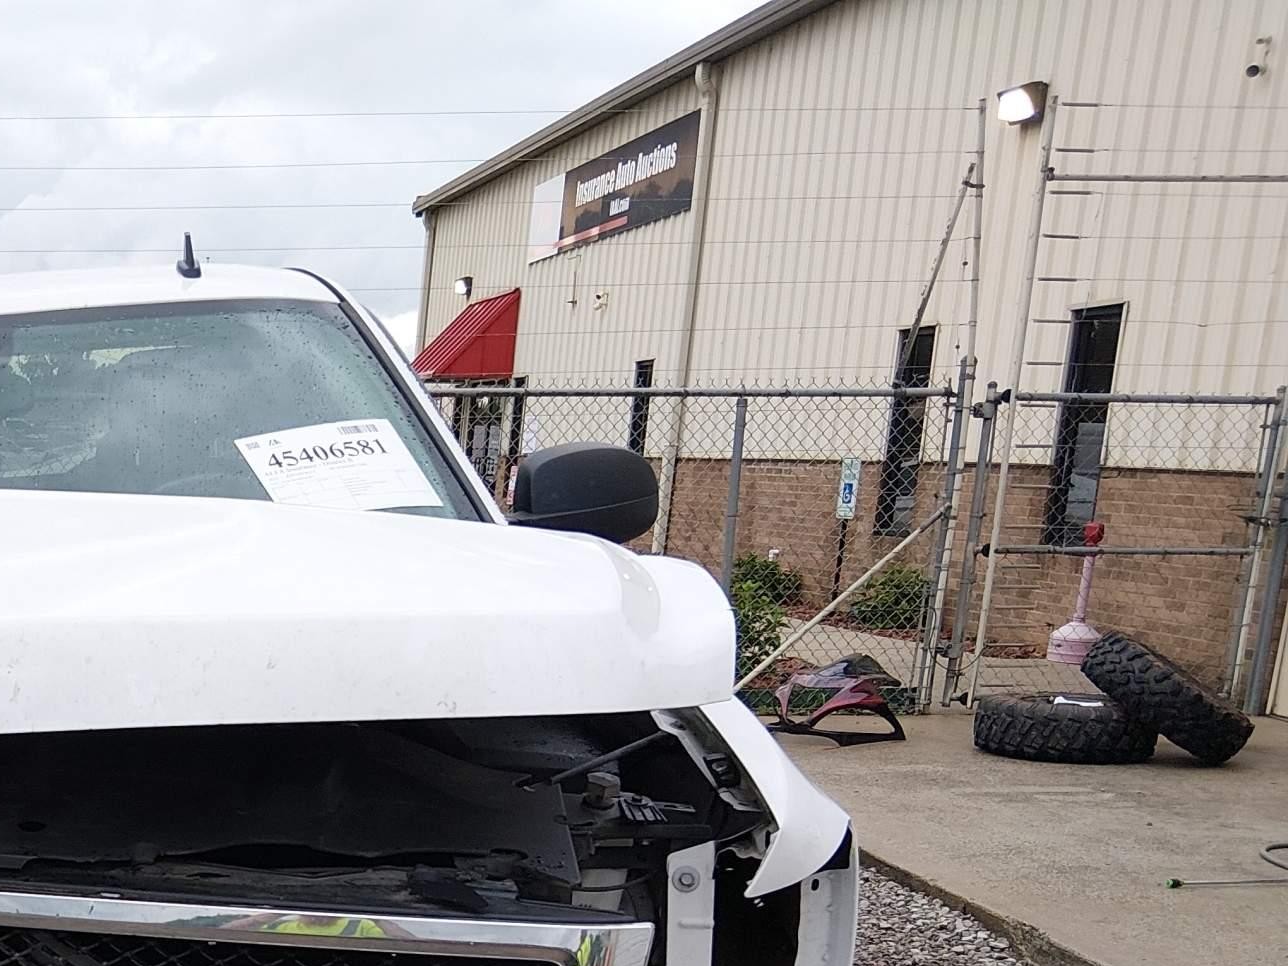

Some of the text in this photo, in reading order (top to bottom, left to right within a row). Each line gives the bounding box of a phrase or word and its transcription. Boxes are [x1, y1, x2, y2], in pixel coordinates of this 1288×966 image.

[575, 141, 678, 208] Insurance Auto Auctions
[268, 438, 389, 469] 45406581
